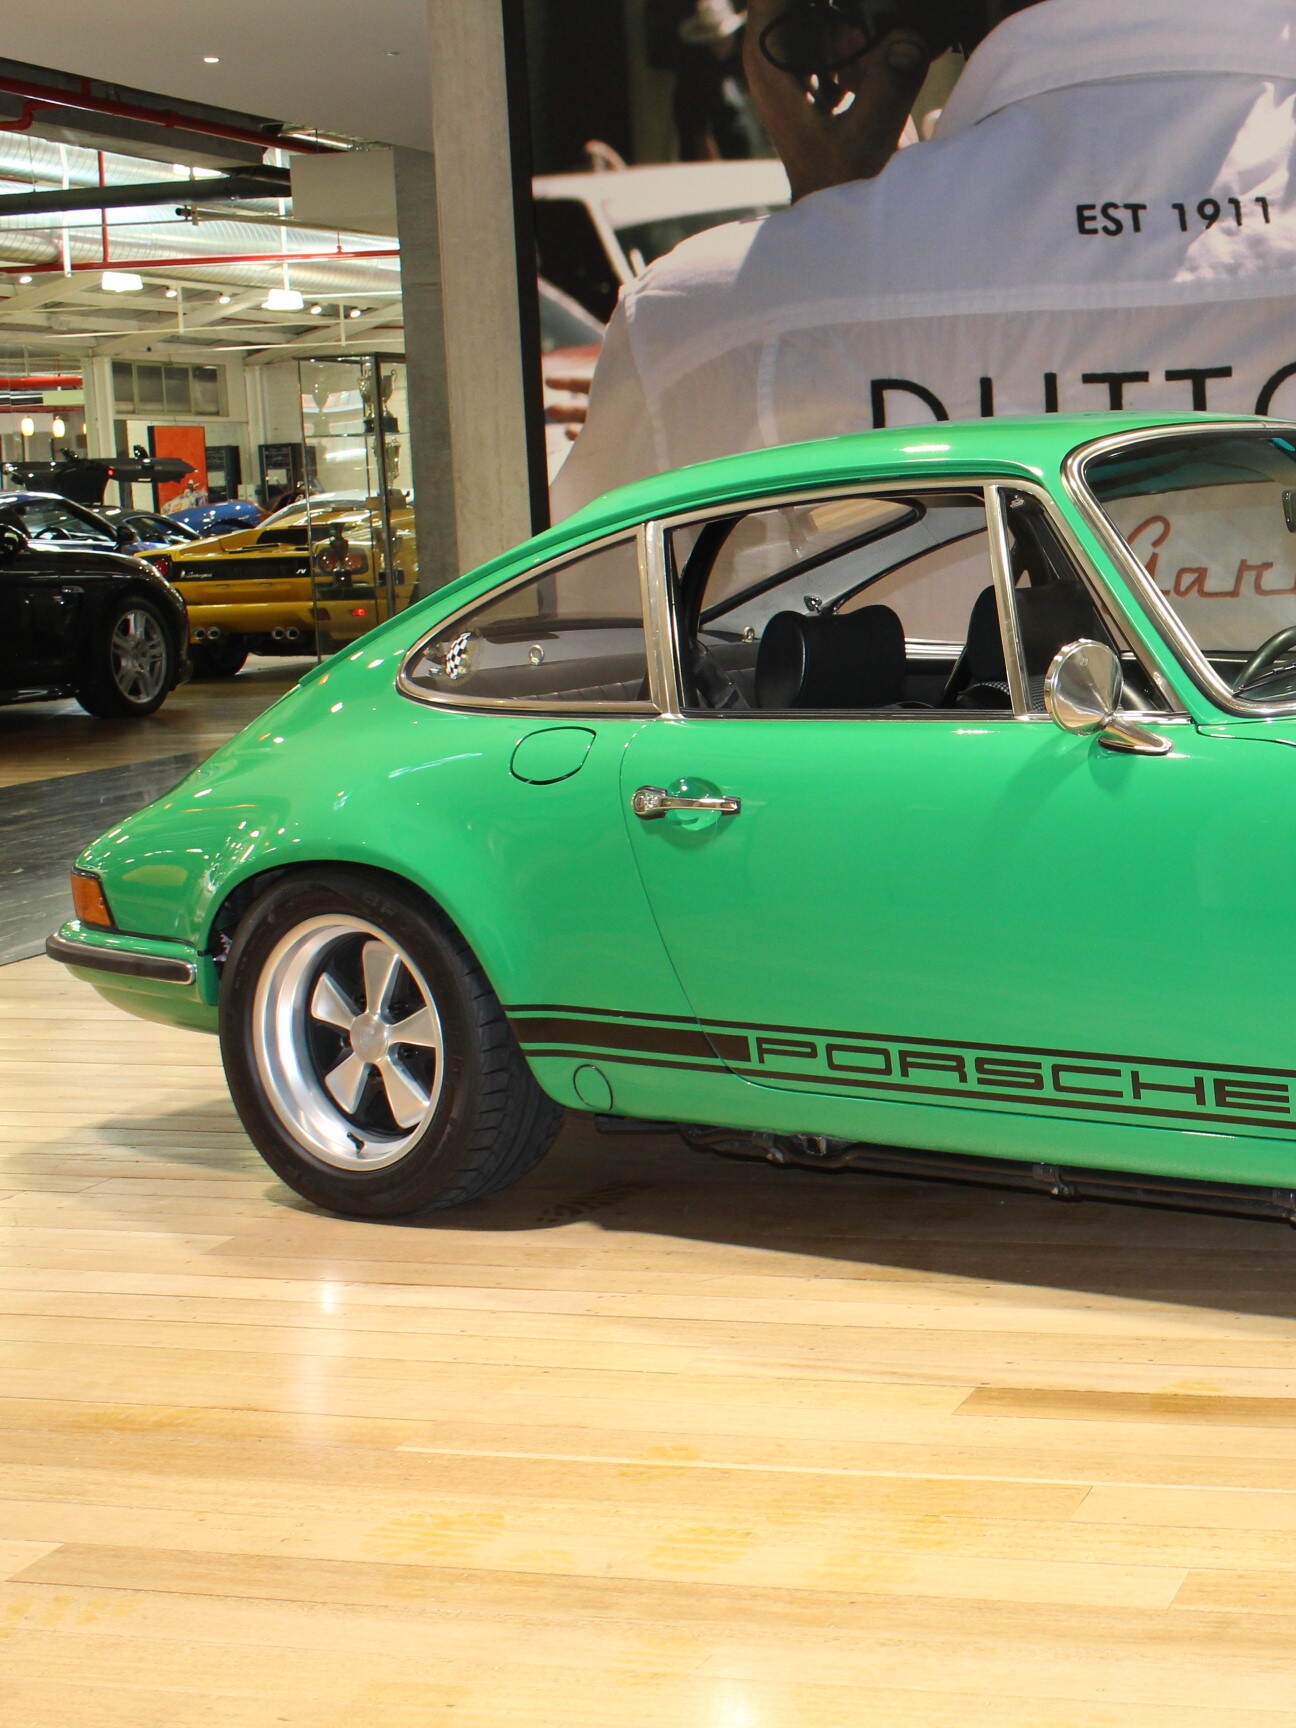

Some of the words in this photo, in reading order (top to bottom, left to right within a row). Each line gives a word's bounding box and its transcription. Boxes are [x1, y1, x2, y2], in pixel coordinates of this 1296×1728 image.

[1076, 202, 1147, 236] EST
[1171, 197, 1270, 232] 1911
[756, 1036, 1292, 1114] PORSCHE
